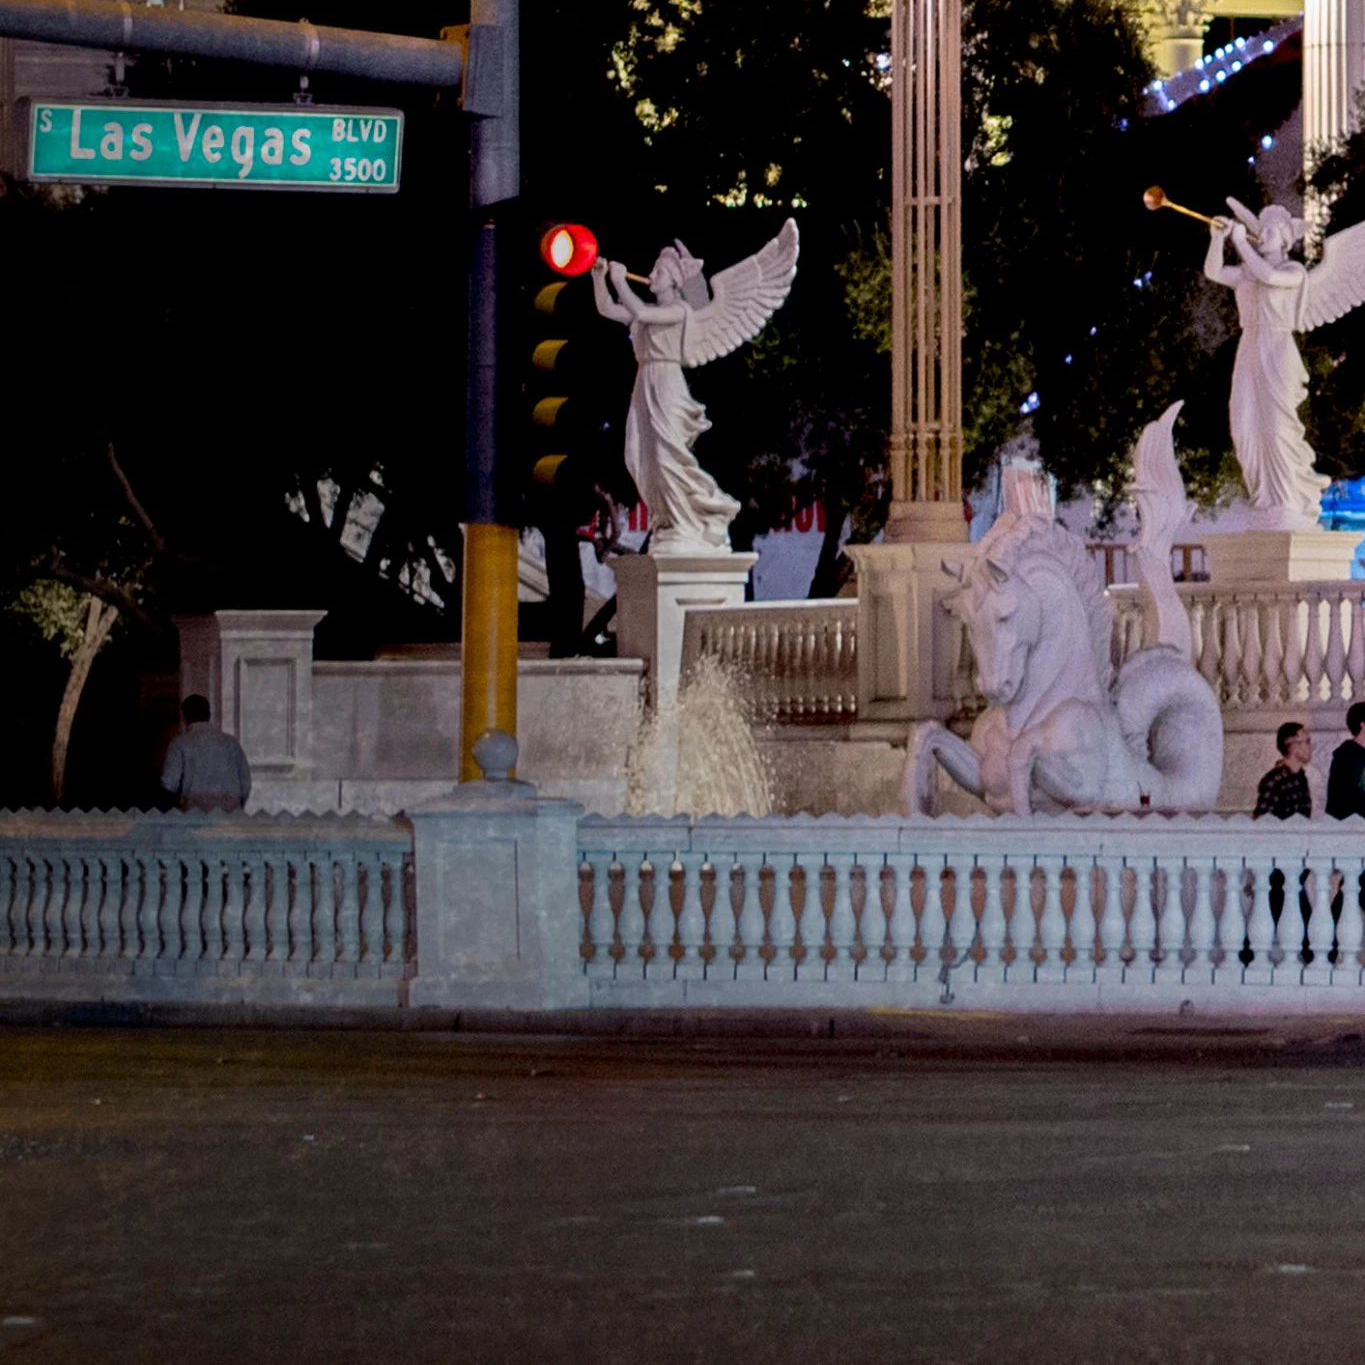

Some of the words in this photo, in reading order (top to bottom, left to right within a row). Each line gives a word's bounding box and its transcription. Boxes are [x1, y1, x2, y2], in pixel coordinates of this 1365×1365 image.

[38, 110, 53, 133] S
[69, 107, 153, 162] Las
[173, 110, 313, 180] Vegas
[331, 117, 387, 143] BLVD
[328, 157, 387, 182] 3500
